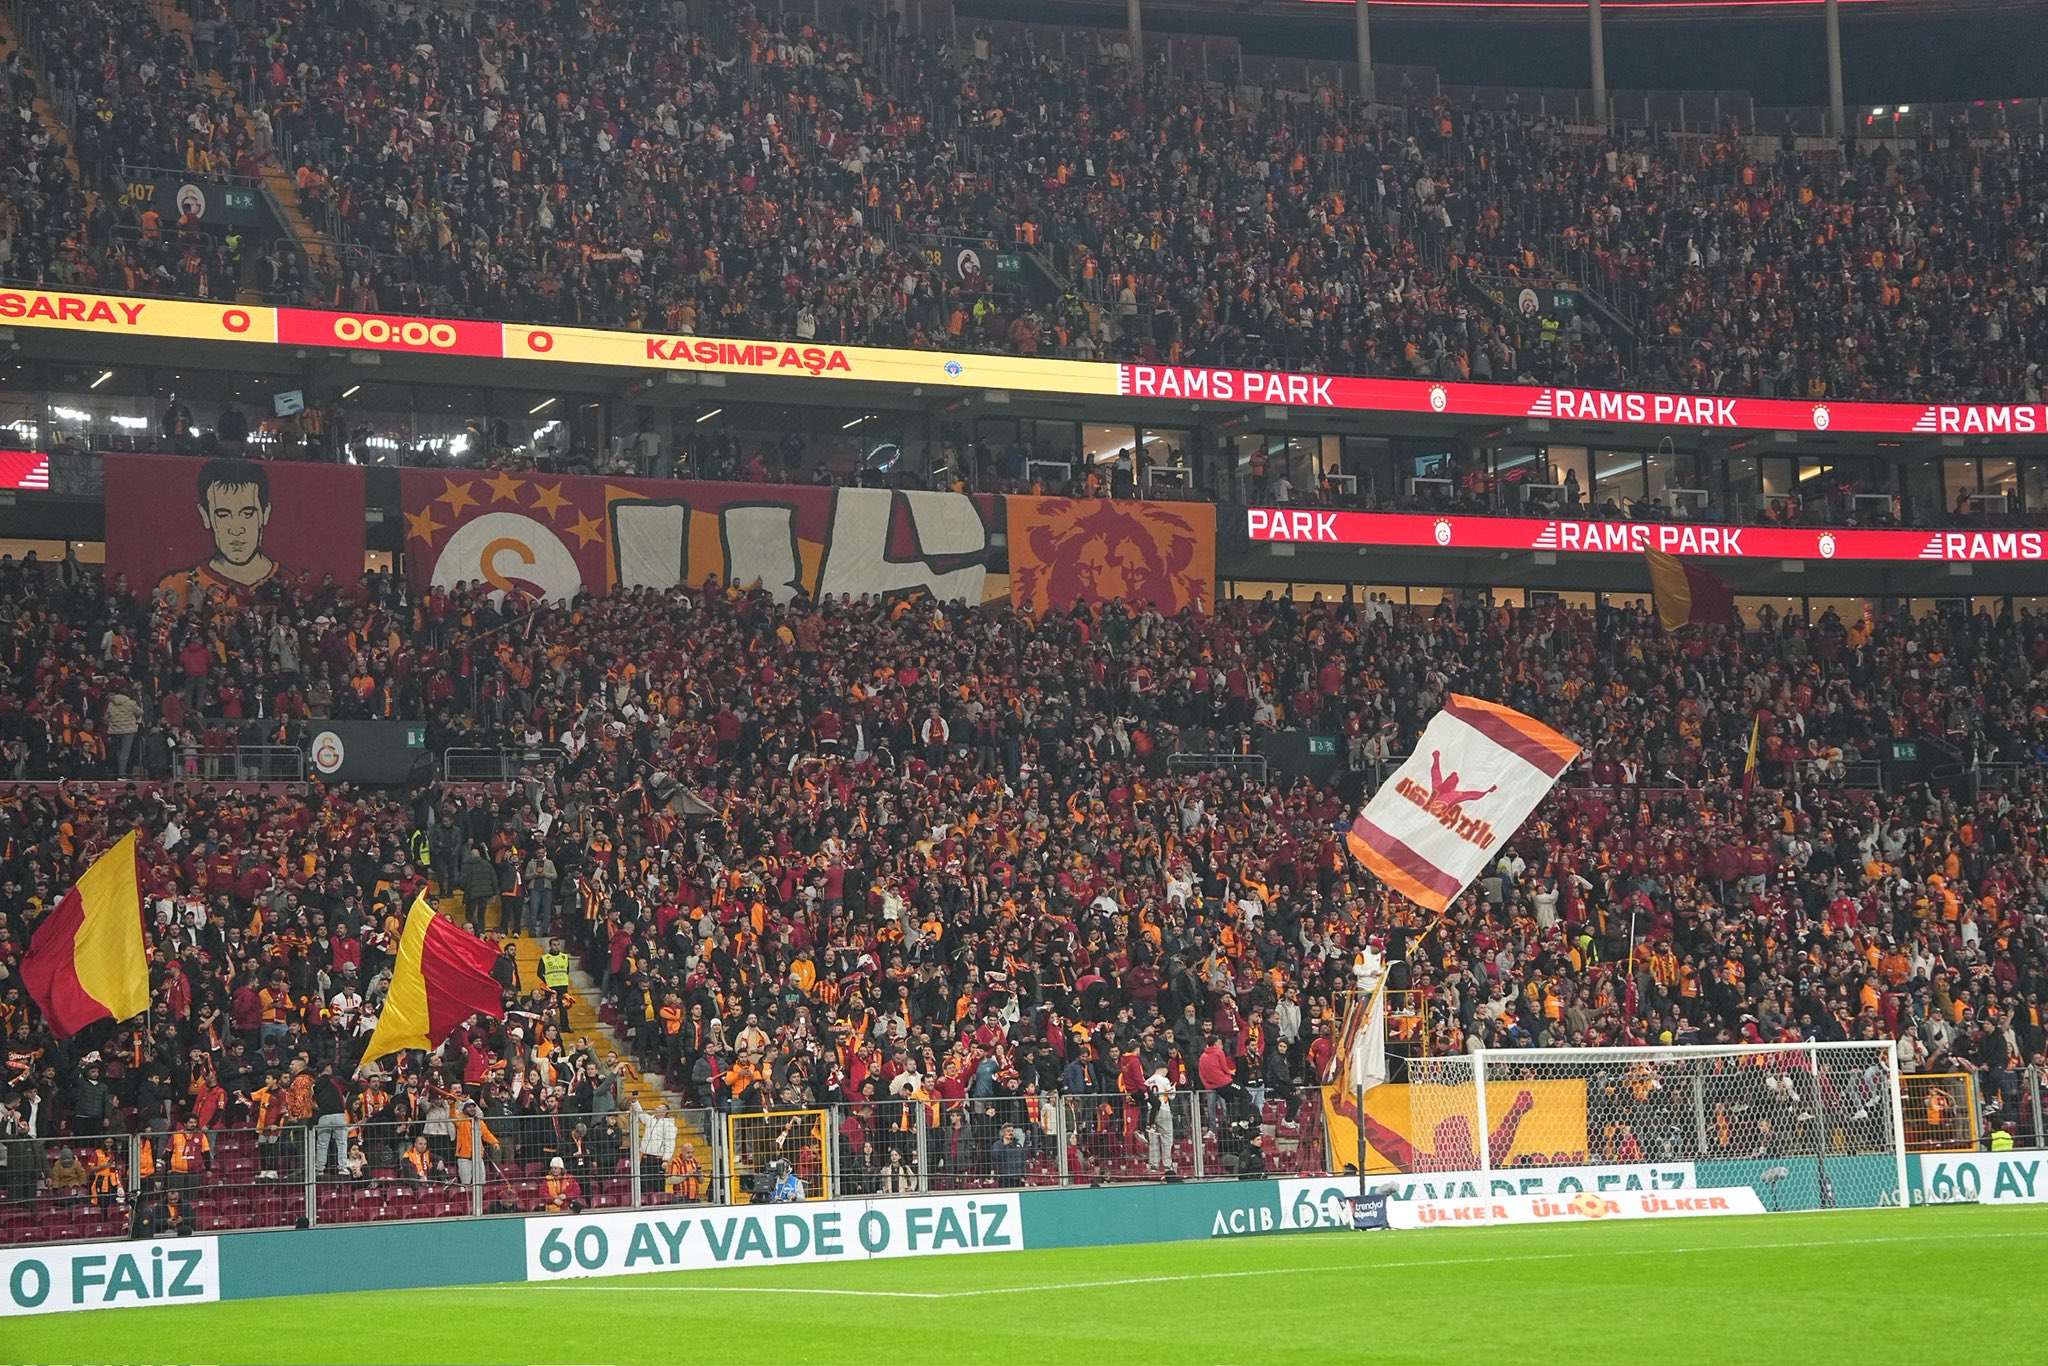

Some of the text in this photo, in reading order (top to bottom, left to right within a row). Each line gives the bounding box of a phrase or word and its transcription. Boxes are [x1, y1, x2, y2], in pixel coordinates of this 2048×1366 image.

[0, 293, 146, 325] SARAY
[222, 309, 251, 333] 0
[333, 317, 457, 348] 00:00
[527, 331, 553, 353] 0
[646, 338, 851, 376] KASIMPAŞA
[1134, 366, 1334, 405] RAMS PARK
[1555, 389, 1738, 426] RAMS PARK
[1940, 406, 2036, 433] RAMS
[1247, 509, 1338, 541] PARK
[1560, 522, 1743, 555] RAMS PARK
[1946, 533, 2043, 559] RAMS
[1932, 1160, 2040, 1201] 60 AY
[1355, 1200, 1383, 1211] trendyol
[1418, 1203, 1509, 1224] ÜLKER
[1532, 1198, 1621, 1219] ÜLKR
[1641, 1194, 1730, 1214] ÜLKER
[539, 1225, 609, 1273] 60
[624, 1220, 692, 1267] AY
[700, 1212, 844, 1260] VADE
[858, 1210, 890, 1253] 0
[9, 1259, 51, 1308] 0
